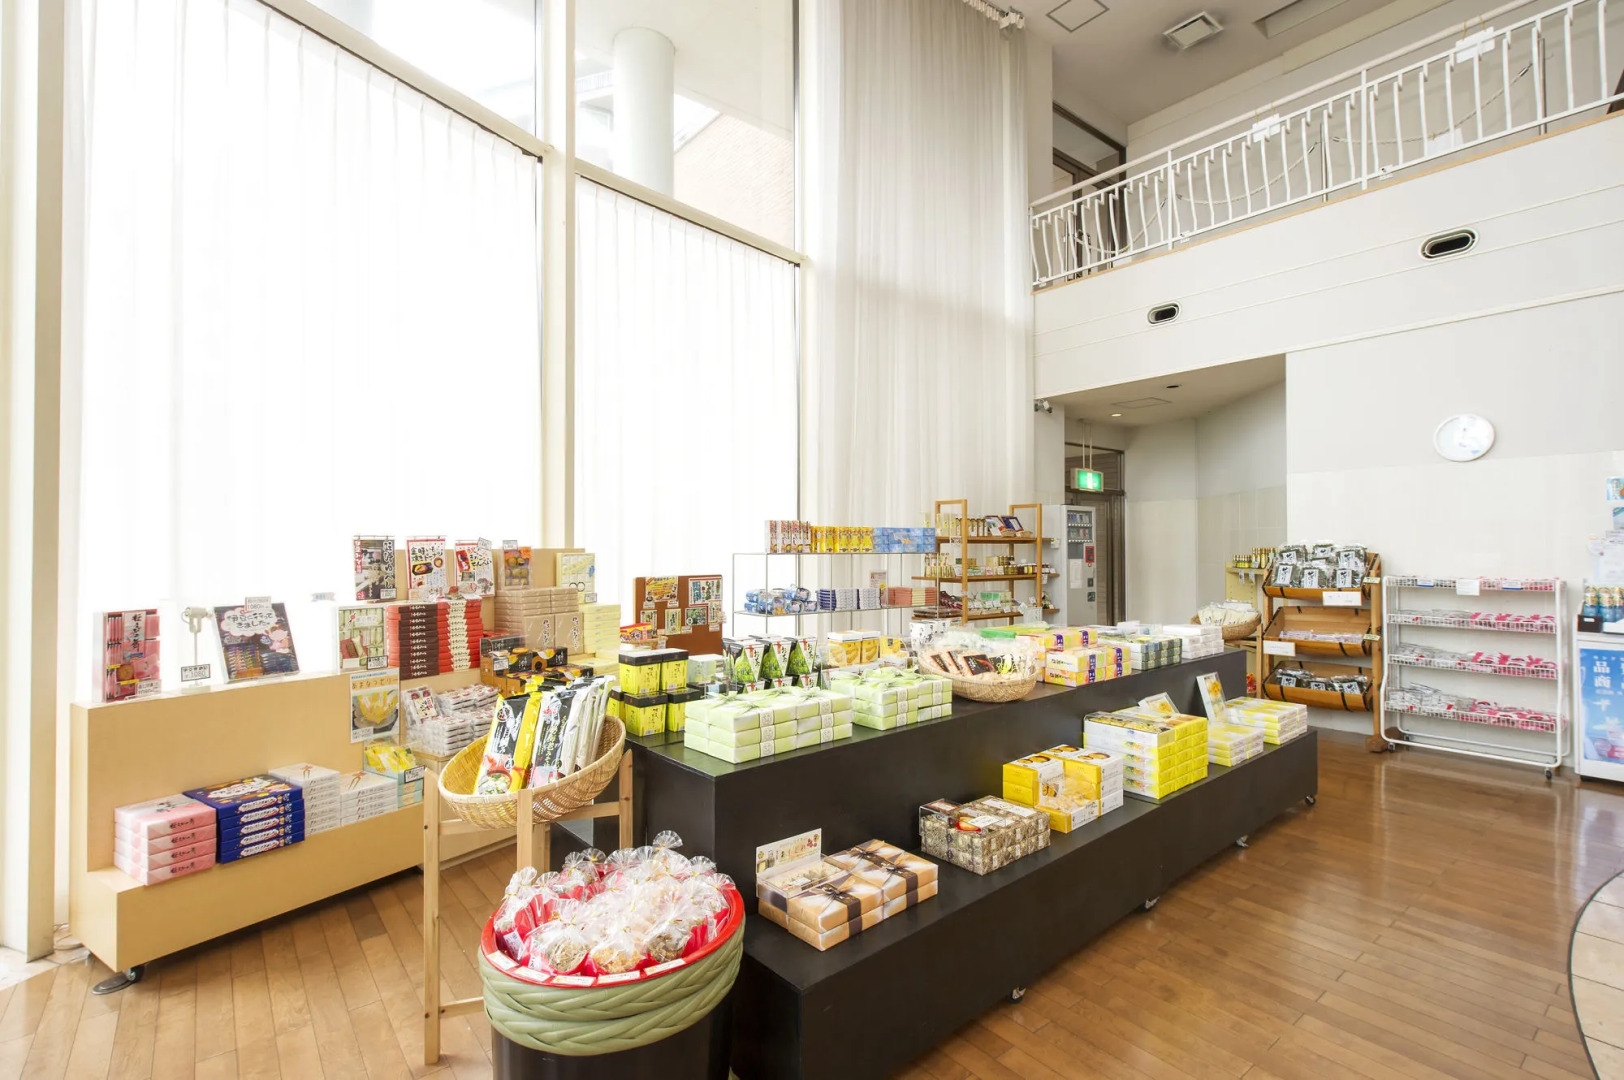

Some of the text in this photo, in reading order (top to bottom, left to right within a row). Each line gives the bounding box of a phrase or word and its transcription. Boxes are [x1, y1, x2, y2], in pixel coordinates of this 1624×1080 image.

[226, 612, 274, 623] 伊豆に行って
[352, 678, 398, 690] あまなつゼリー
